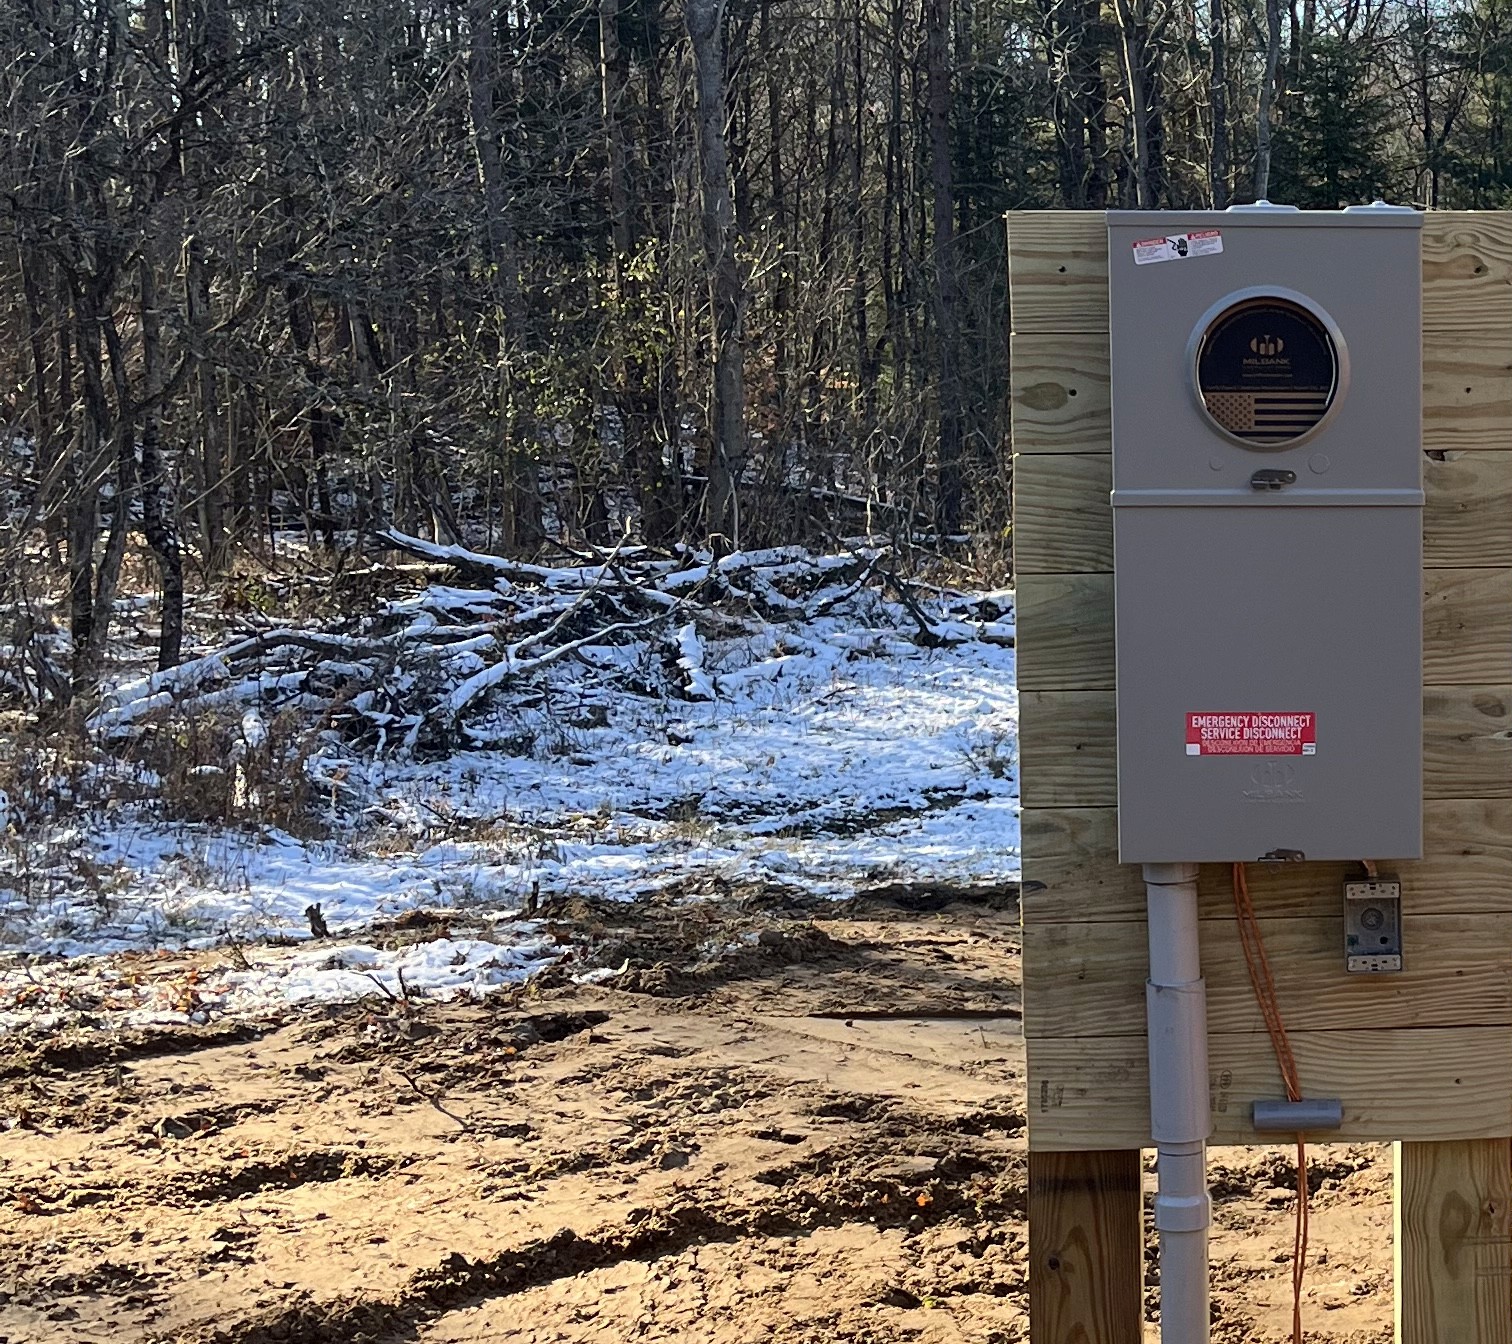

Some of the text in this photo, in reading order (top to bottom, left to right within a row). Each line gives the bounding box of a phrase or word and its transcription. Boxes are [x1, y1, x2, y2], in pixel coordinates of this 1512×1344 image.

[1191, 715, 1311, 728] EMERGENCY DISCONNECT
[1201, 727, 1302, 740] SERVICE DISCONNECT
